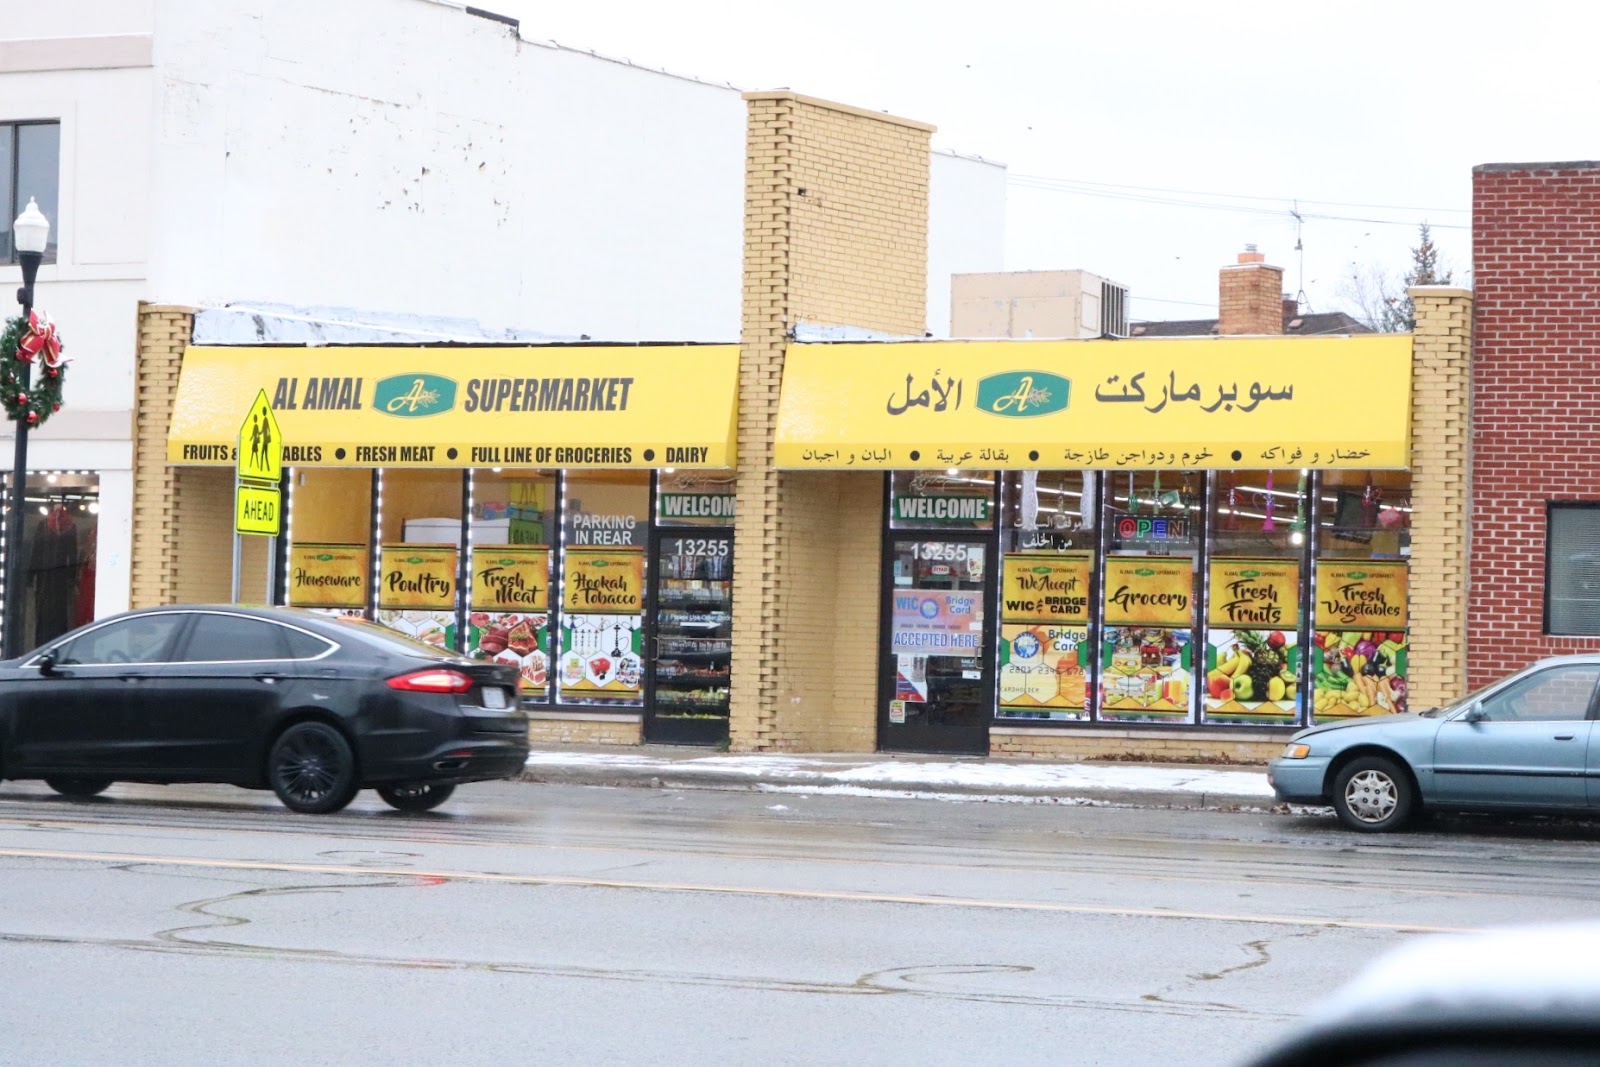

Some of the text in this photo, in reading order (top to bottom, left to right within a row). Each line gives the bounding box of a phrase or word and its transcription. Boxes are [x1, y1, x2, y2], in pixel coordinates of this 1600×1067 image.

[272, 377, 298, 410] AL
[302, 377, 363, 410] AMAL
[465, 377, 634, 412] SUPERMARKET
[886, 368, 962, 416] الأمل
[1095, 369, 1293, 413] سوبرماركت
[183, 444, 228, 460] FRUITS
[281, 446, 322, 461] ABLES
[356, 446, 397, 462] FRESH
[400, 446, 435, 462] MEAT
[471, 447, 501, 463] FULL
[504, 447, 532, 463] LINE
[535, 447, 552, 463] OF
[555, 447, 632, 463] GROCERIES
[666, 447, 708, 463] DAIRY
[802, 448, 892, 465] البان و اجبان
[937, 448, 1009, 465] بقالة عربية
[1064, 448, 1109, 465] طازجة
[1260, 446, 1371, 464] خضار و فواكه
[243, 500, 274, 521] AHEAD
[664, 496, 736, 516] WELCOM
[899, 498, 985, 519] WELCOME
[573, 515, 636, 529] PARKING
[1119, 518, 1184, 539] OPEN
[575, 530, 632, 545] IN REAR
[1058, 539, 1073, 553] من
[675, 539, 729, 556] 13255
[911, 543, 967, 561] 13255
[295, 567, 361, 588] Houseware
[384, 570, 450, 598] Poultry
[477, 567, 524, 591] Fresh
[571, 571, 628, 591] Hookah
[1016, 574, 1081, 595] We Accept
[495, 585, 545, 604] Meat
[571, 587, 637, 605] & Tobacco
[1108, 585, 1187, 613] Grocery
[1225, 579, 1278, 603] Fresh
[1336, 582, 1385, 604] Fresh
[896, 597, 919, 611] WIC
[946, 596, 975, 607] Bridge
[949, 605, 971, 614] Card
[1006, 600, 1035, 611] WIC
[1044, 596, 1087, 606] BRIDGE
[1050, 605, 1082, 614] CARD
[1220, 599, 1283, 624] Fruits
[1320, 600, 1401, 624] Vegetables
[894, 632, 978, 648] ACCEPTED HERE
[1048, 629, 1086, 643] Bridge
